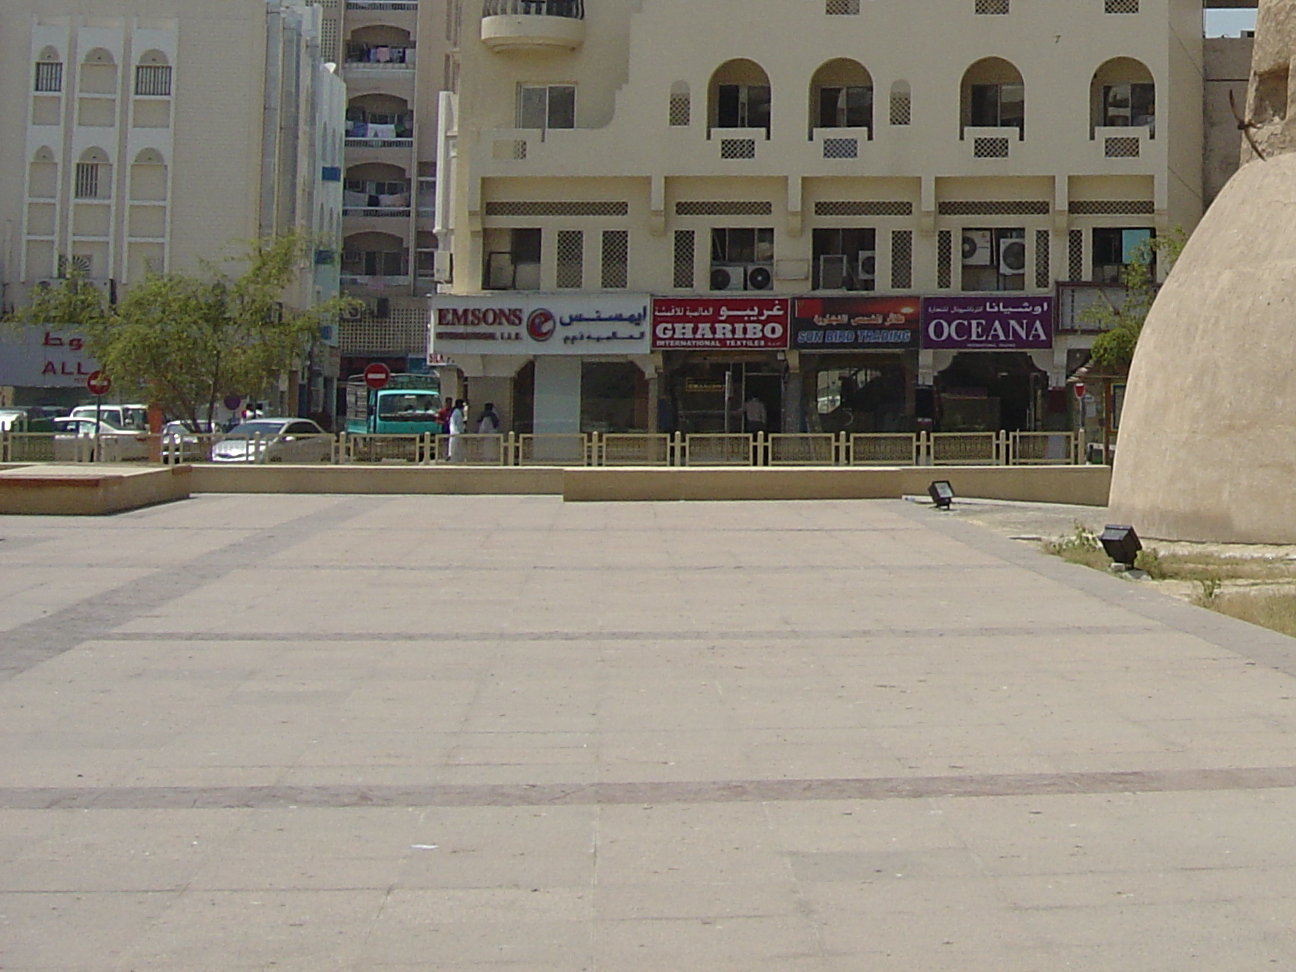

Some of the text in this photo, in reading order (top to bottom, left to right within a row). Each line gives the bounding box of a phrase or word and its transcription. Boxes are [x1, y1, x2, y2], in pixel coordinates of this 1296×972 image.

[437, 308, 523, 326] EMSONS
[655, 323, 784, 338] GHARIBO
[797, 330, 911, 343] SUN BIRD TRADING
[928, 319, 1047, 341] OCEANA
